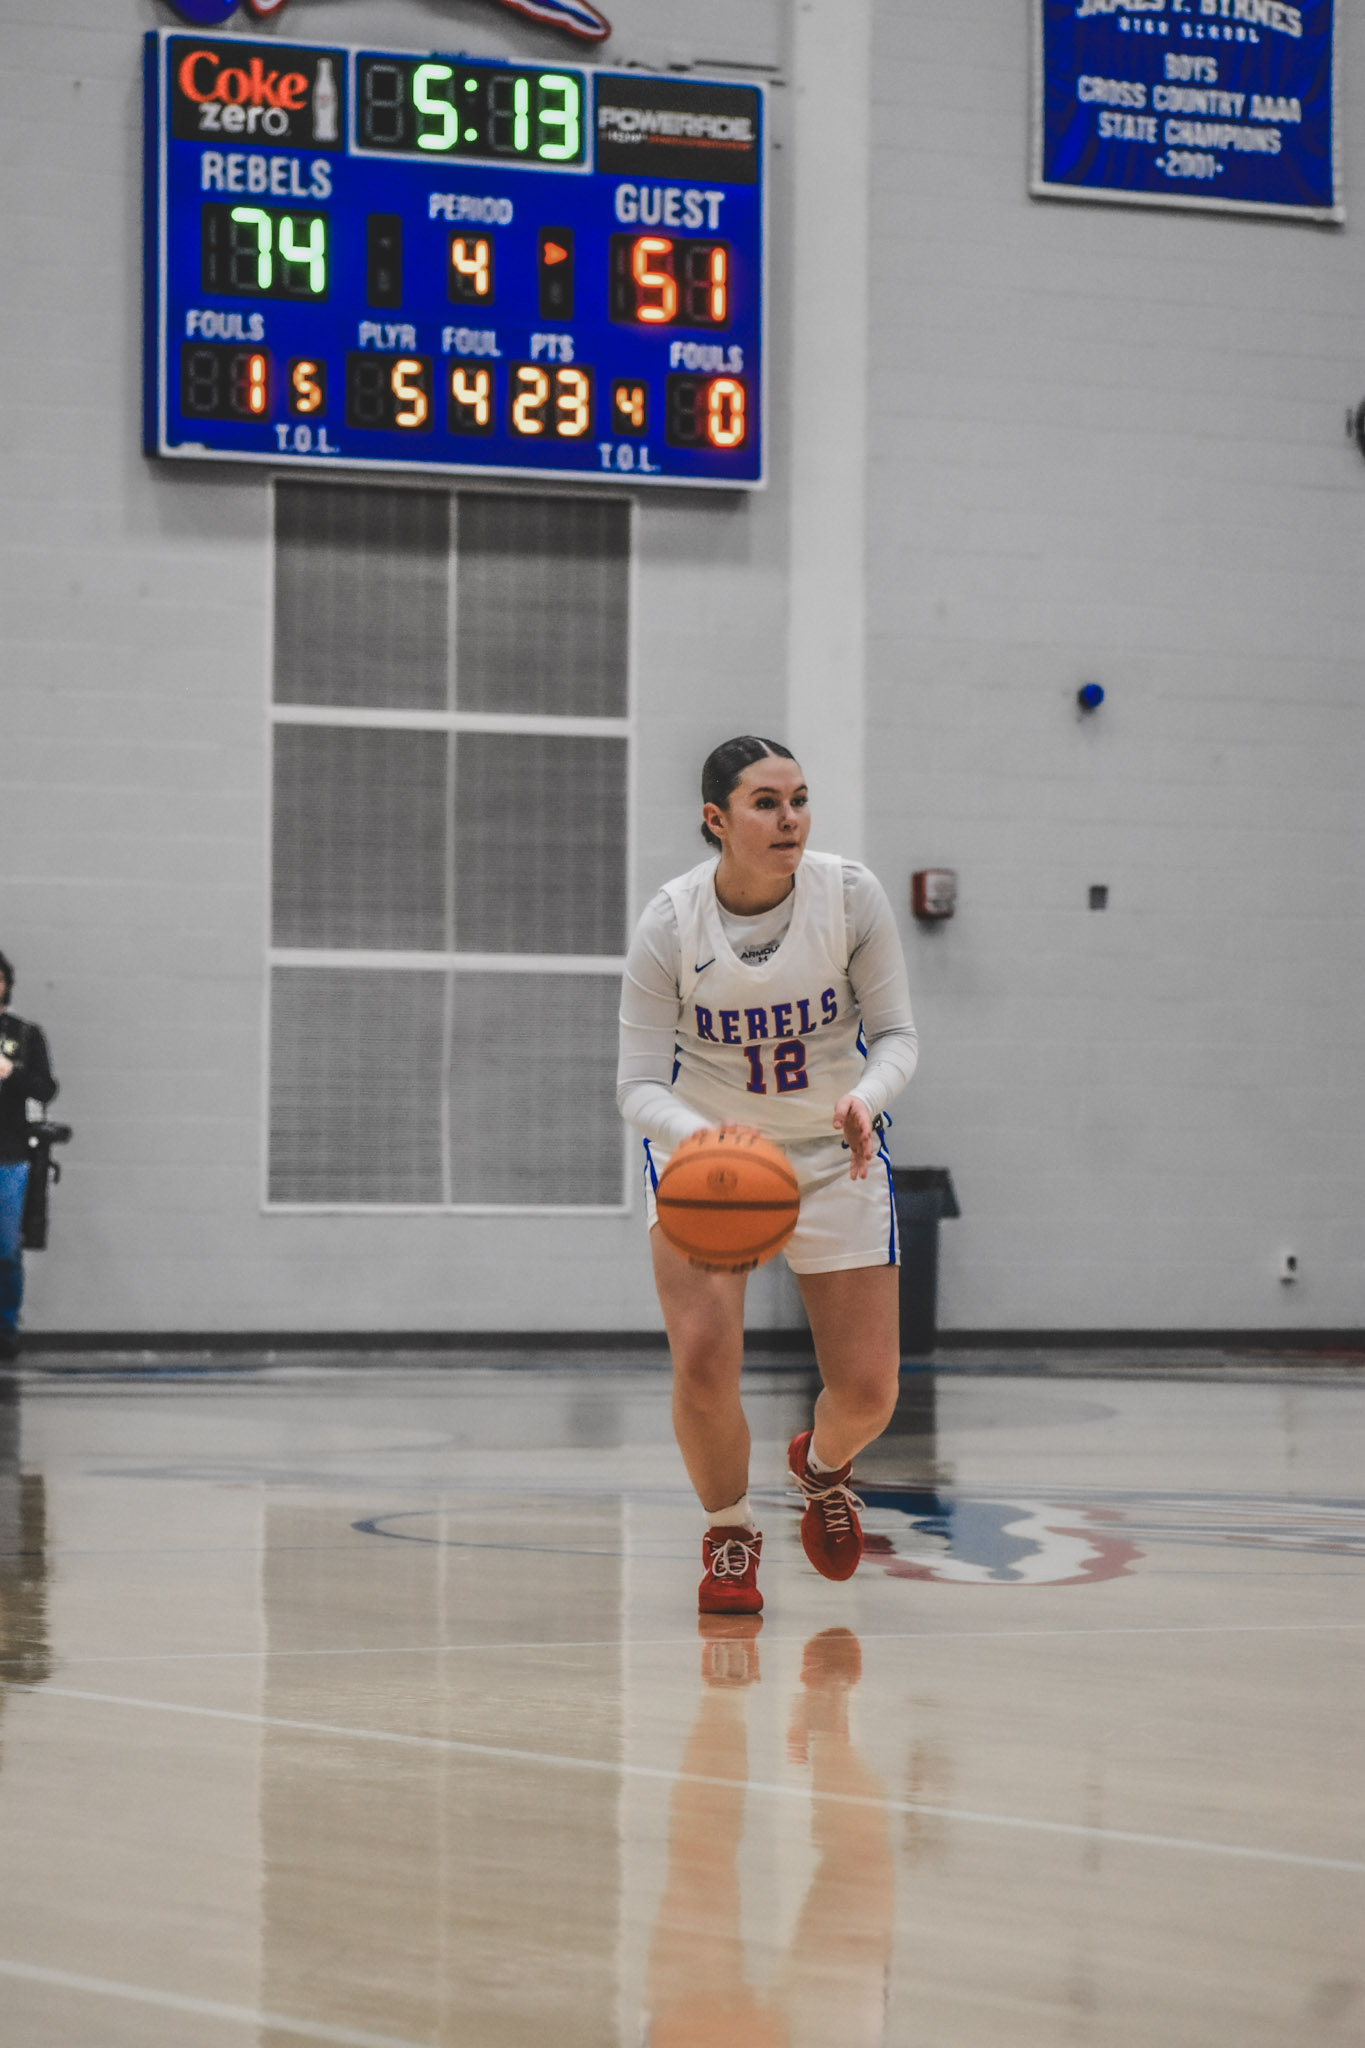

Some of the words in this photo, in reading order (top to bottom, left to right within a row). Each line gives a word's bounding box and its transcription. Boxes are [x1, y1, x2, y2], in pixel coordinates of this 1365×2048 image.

[1118, 16, 1169, 36] HIGH
[1181, 22, 1260, 43] SCHOOL
[178, 50, 309, 110] Coke
[1164, 52, 1218, 84] BOYS
[198, 102, 289, 136] zero
[412, 64, 579, 160] 5:13
[598, 105, 753, 141] POWERADE
[1077, 75, 1147, 109] CROSS
[1153, 84, 1245, 118] COUNTRY
[1250, 94, 1302, 123] AAAA
[1098, 110, 1158, 143] STATE
[1164, 118, 1282, 154] CHAMPIONS
[200, 151, 332, 199] REBELS
[428, 192, 514, 226] PERIOD
[614, 183, 726, 230] GUEST
[231, 206, 325, 293] 74
[452, 238, 489, 295] 4
[632, 236, 728, 324] 51
[185, 309, 265, 342] FOULS
[357, 320, 417, 351] PLYR
[441, 325, 502, 357] FOUL
[530, 332, 575, 364] PTS
[669, 340, 744, 374] FOULS
[249, 354, 267, 415] 1
[292, 361, 323, 412] 5
[391, 359, 429, 428] 5
[452, 367, 490, 426] 4
[512, 366, 590, 437] 23
[615, 386, 645, 427] 4
[708, 377, 746, 448] 0
[740, 943, 780, 960] ARMOU
[694, 987, 837, 1046] REBELS
[744, 1039, 808, 1095] 12
